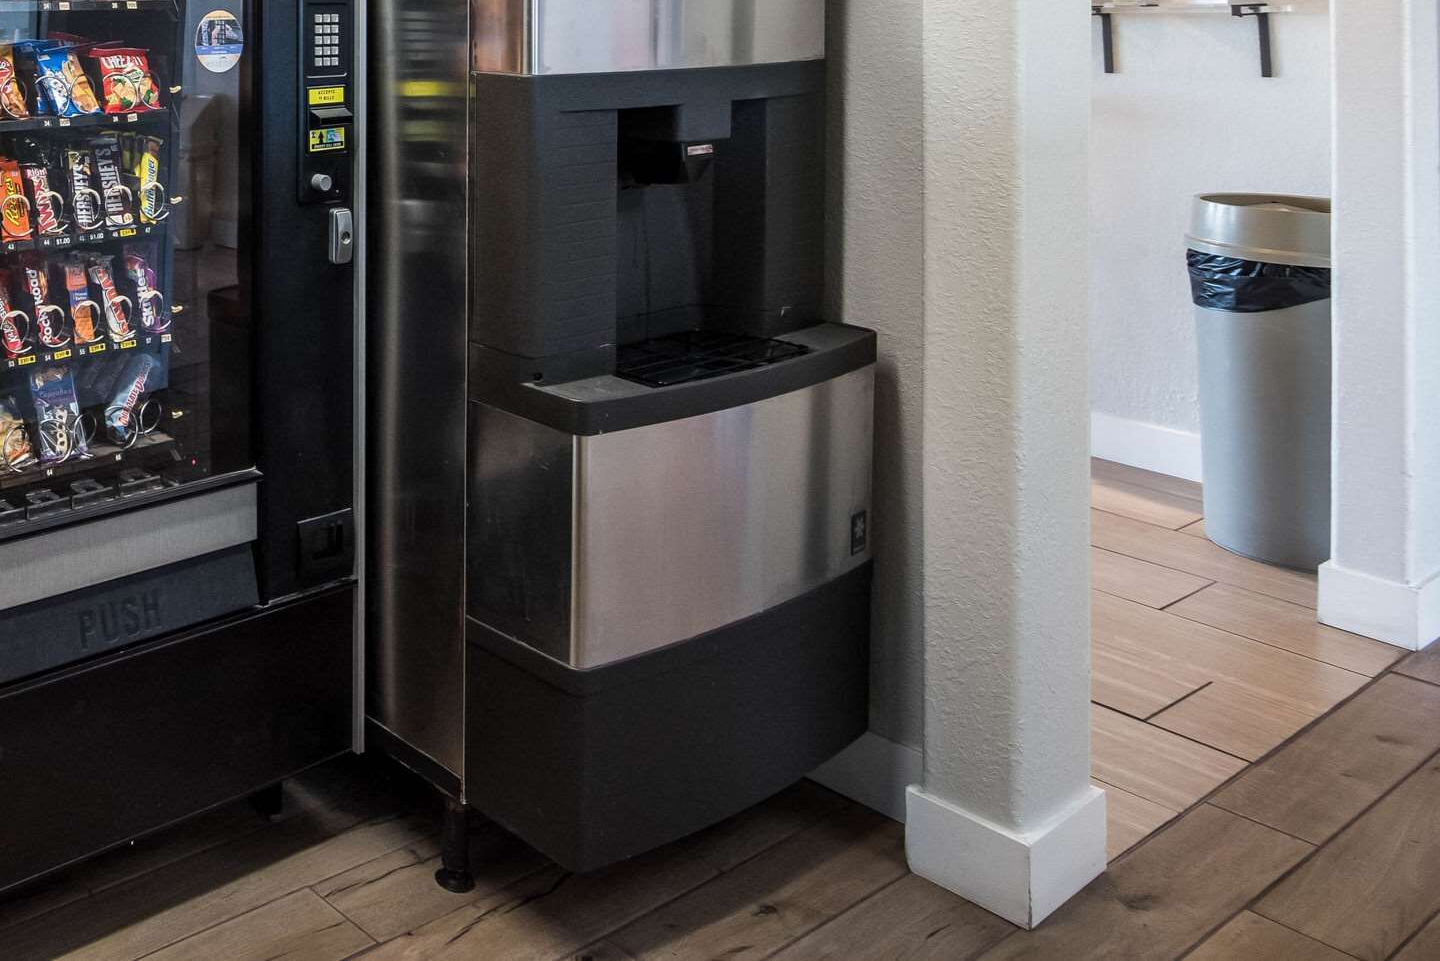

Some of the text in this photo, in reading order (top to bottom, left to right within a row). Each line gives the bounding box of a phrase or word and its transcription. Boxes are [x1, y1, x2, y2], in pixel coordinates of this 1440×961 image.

[96, 148, 124, 212] HERSHEY'S
[38, 305, 53, 343] Rock
[79, 588, 162, 649] PUSH
